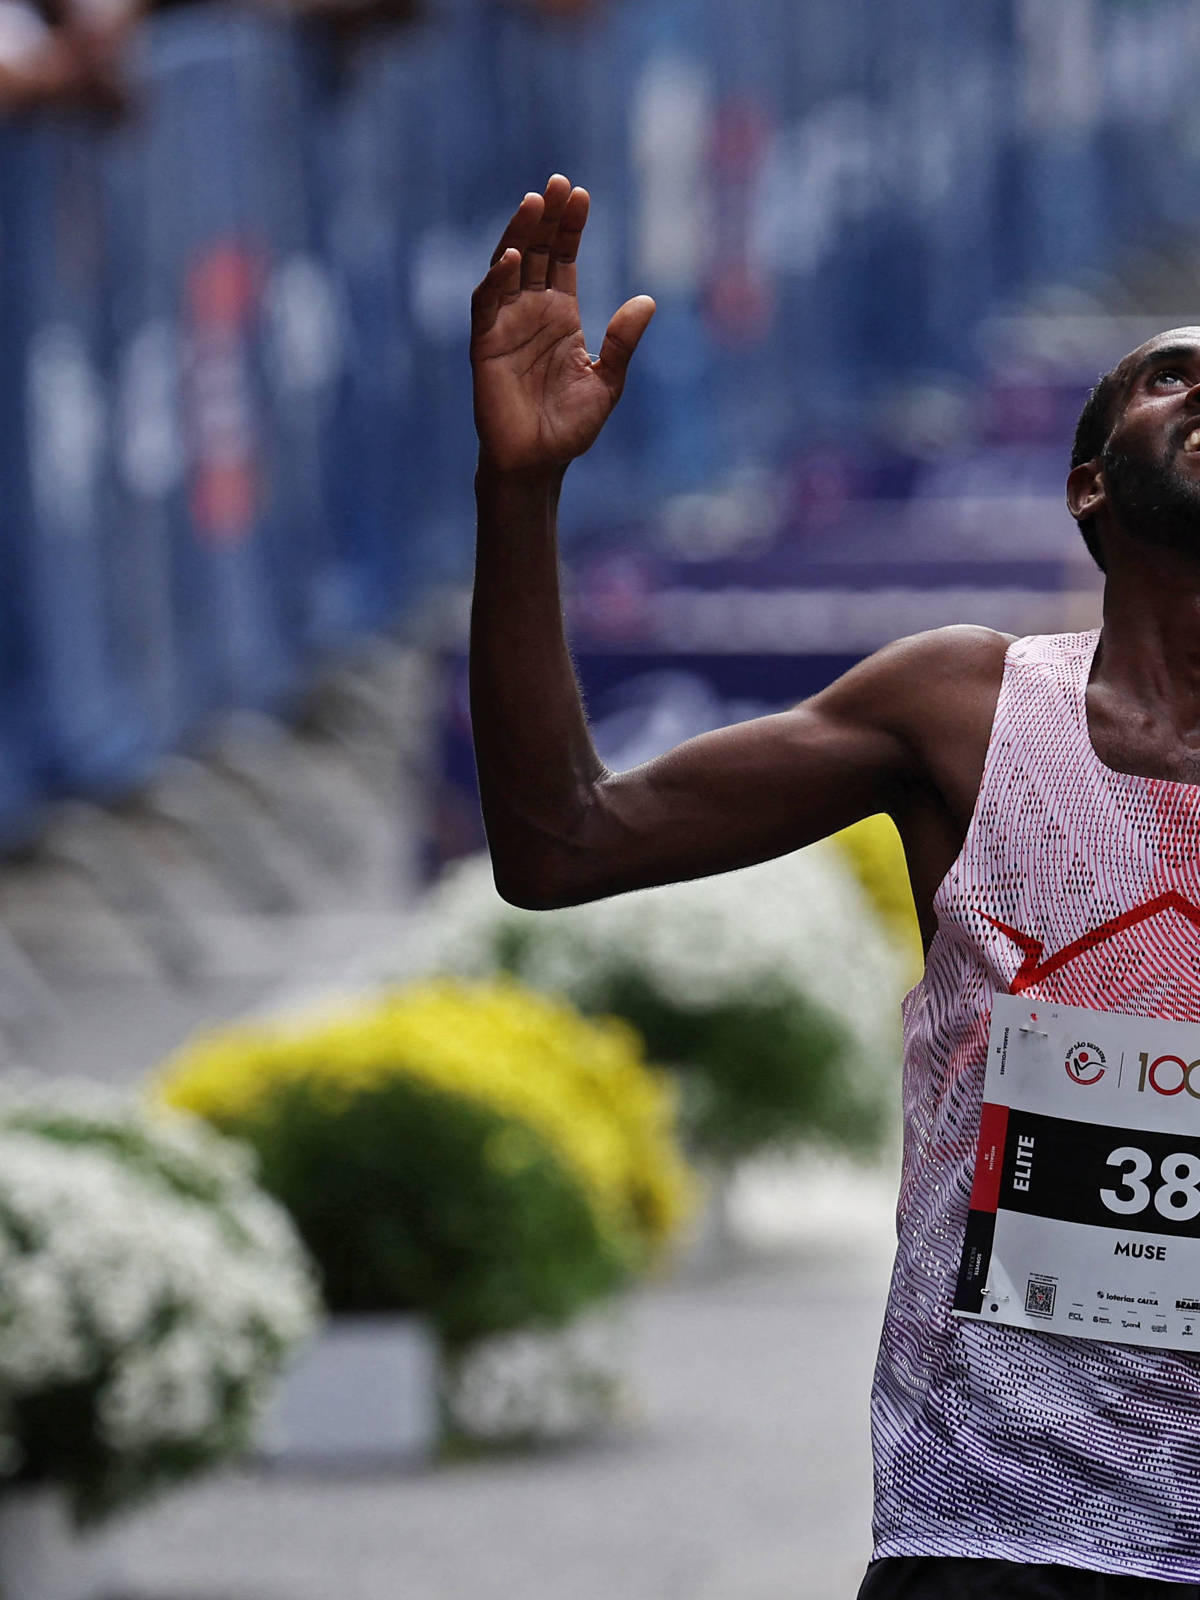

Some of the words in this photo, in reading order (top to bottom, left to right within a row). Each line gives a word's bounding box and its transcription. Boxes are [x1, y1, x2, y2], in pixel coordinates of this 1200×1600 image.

[1074, 1042, 1086, 1050] SÃO
[1013, 1135, 1035, 1192] ELITE
[1114, 1241, 1167, 1261] MUSE
[1106, 1293, 1135, 1303] loterias
[1137, 1297, 1159, 1306] CAIXA
